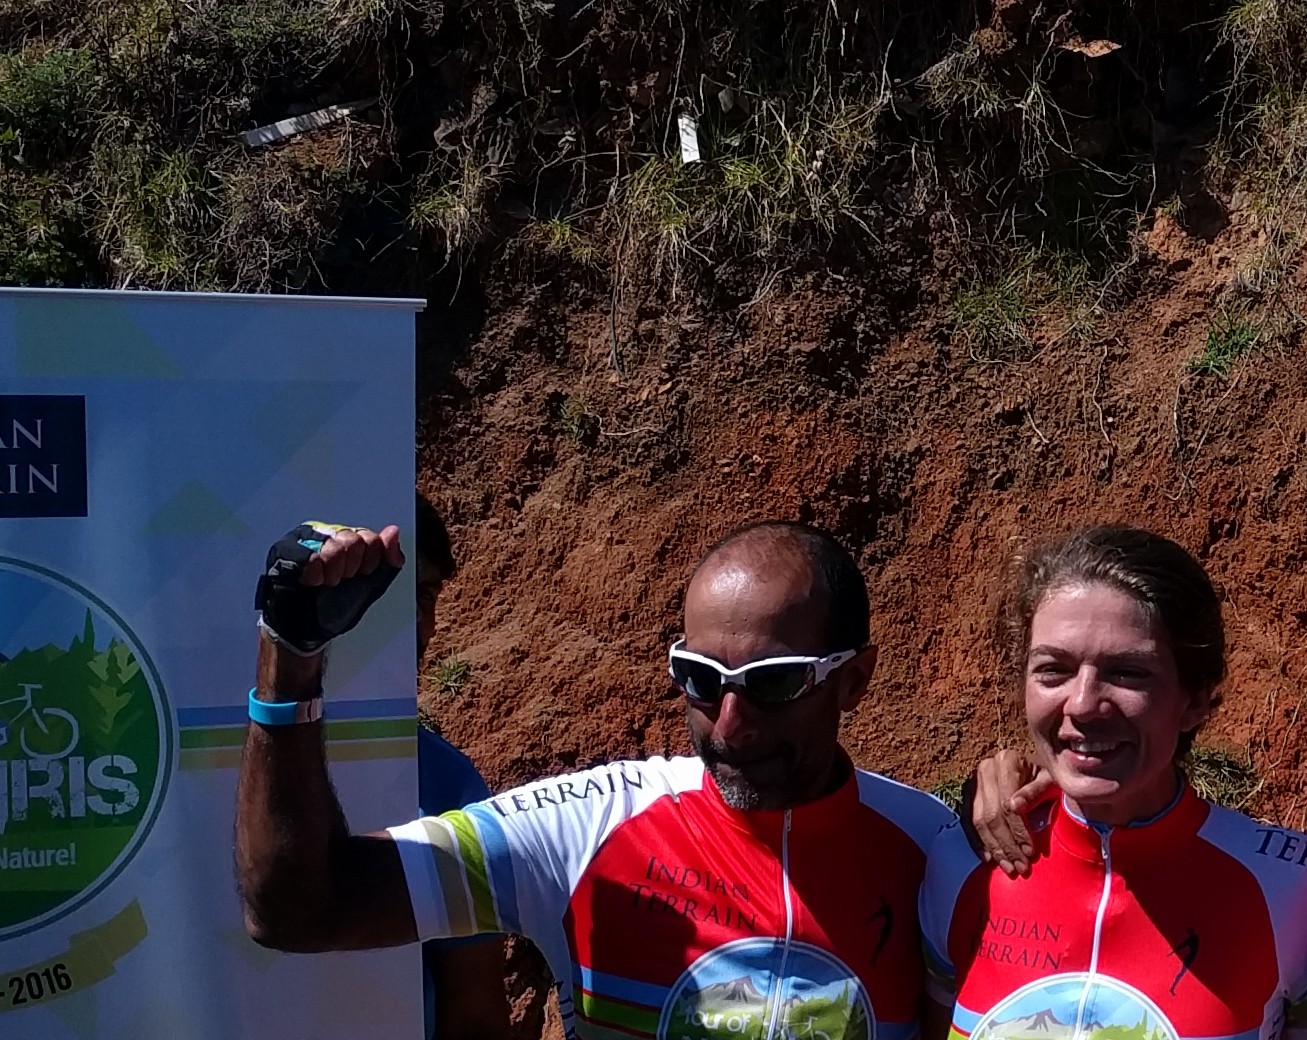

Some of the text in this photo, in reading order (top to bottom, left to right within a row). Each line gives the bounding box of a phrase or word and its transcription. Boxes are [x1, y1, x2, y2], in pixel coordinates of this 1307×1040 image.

[0, 463, 60, 494] IN
[485, 769, 643, 818] TERRAIN
[645, 856, 750, 903] INDIAN
[630, 882, 758, 932] TERRAIN
[8, 963, 72, 1005] 2016
[685, 1004, 751, 1033] tour of
